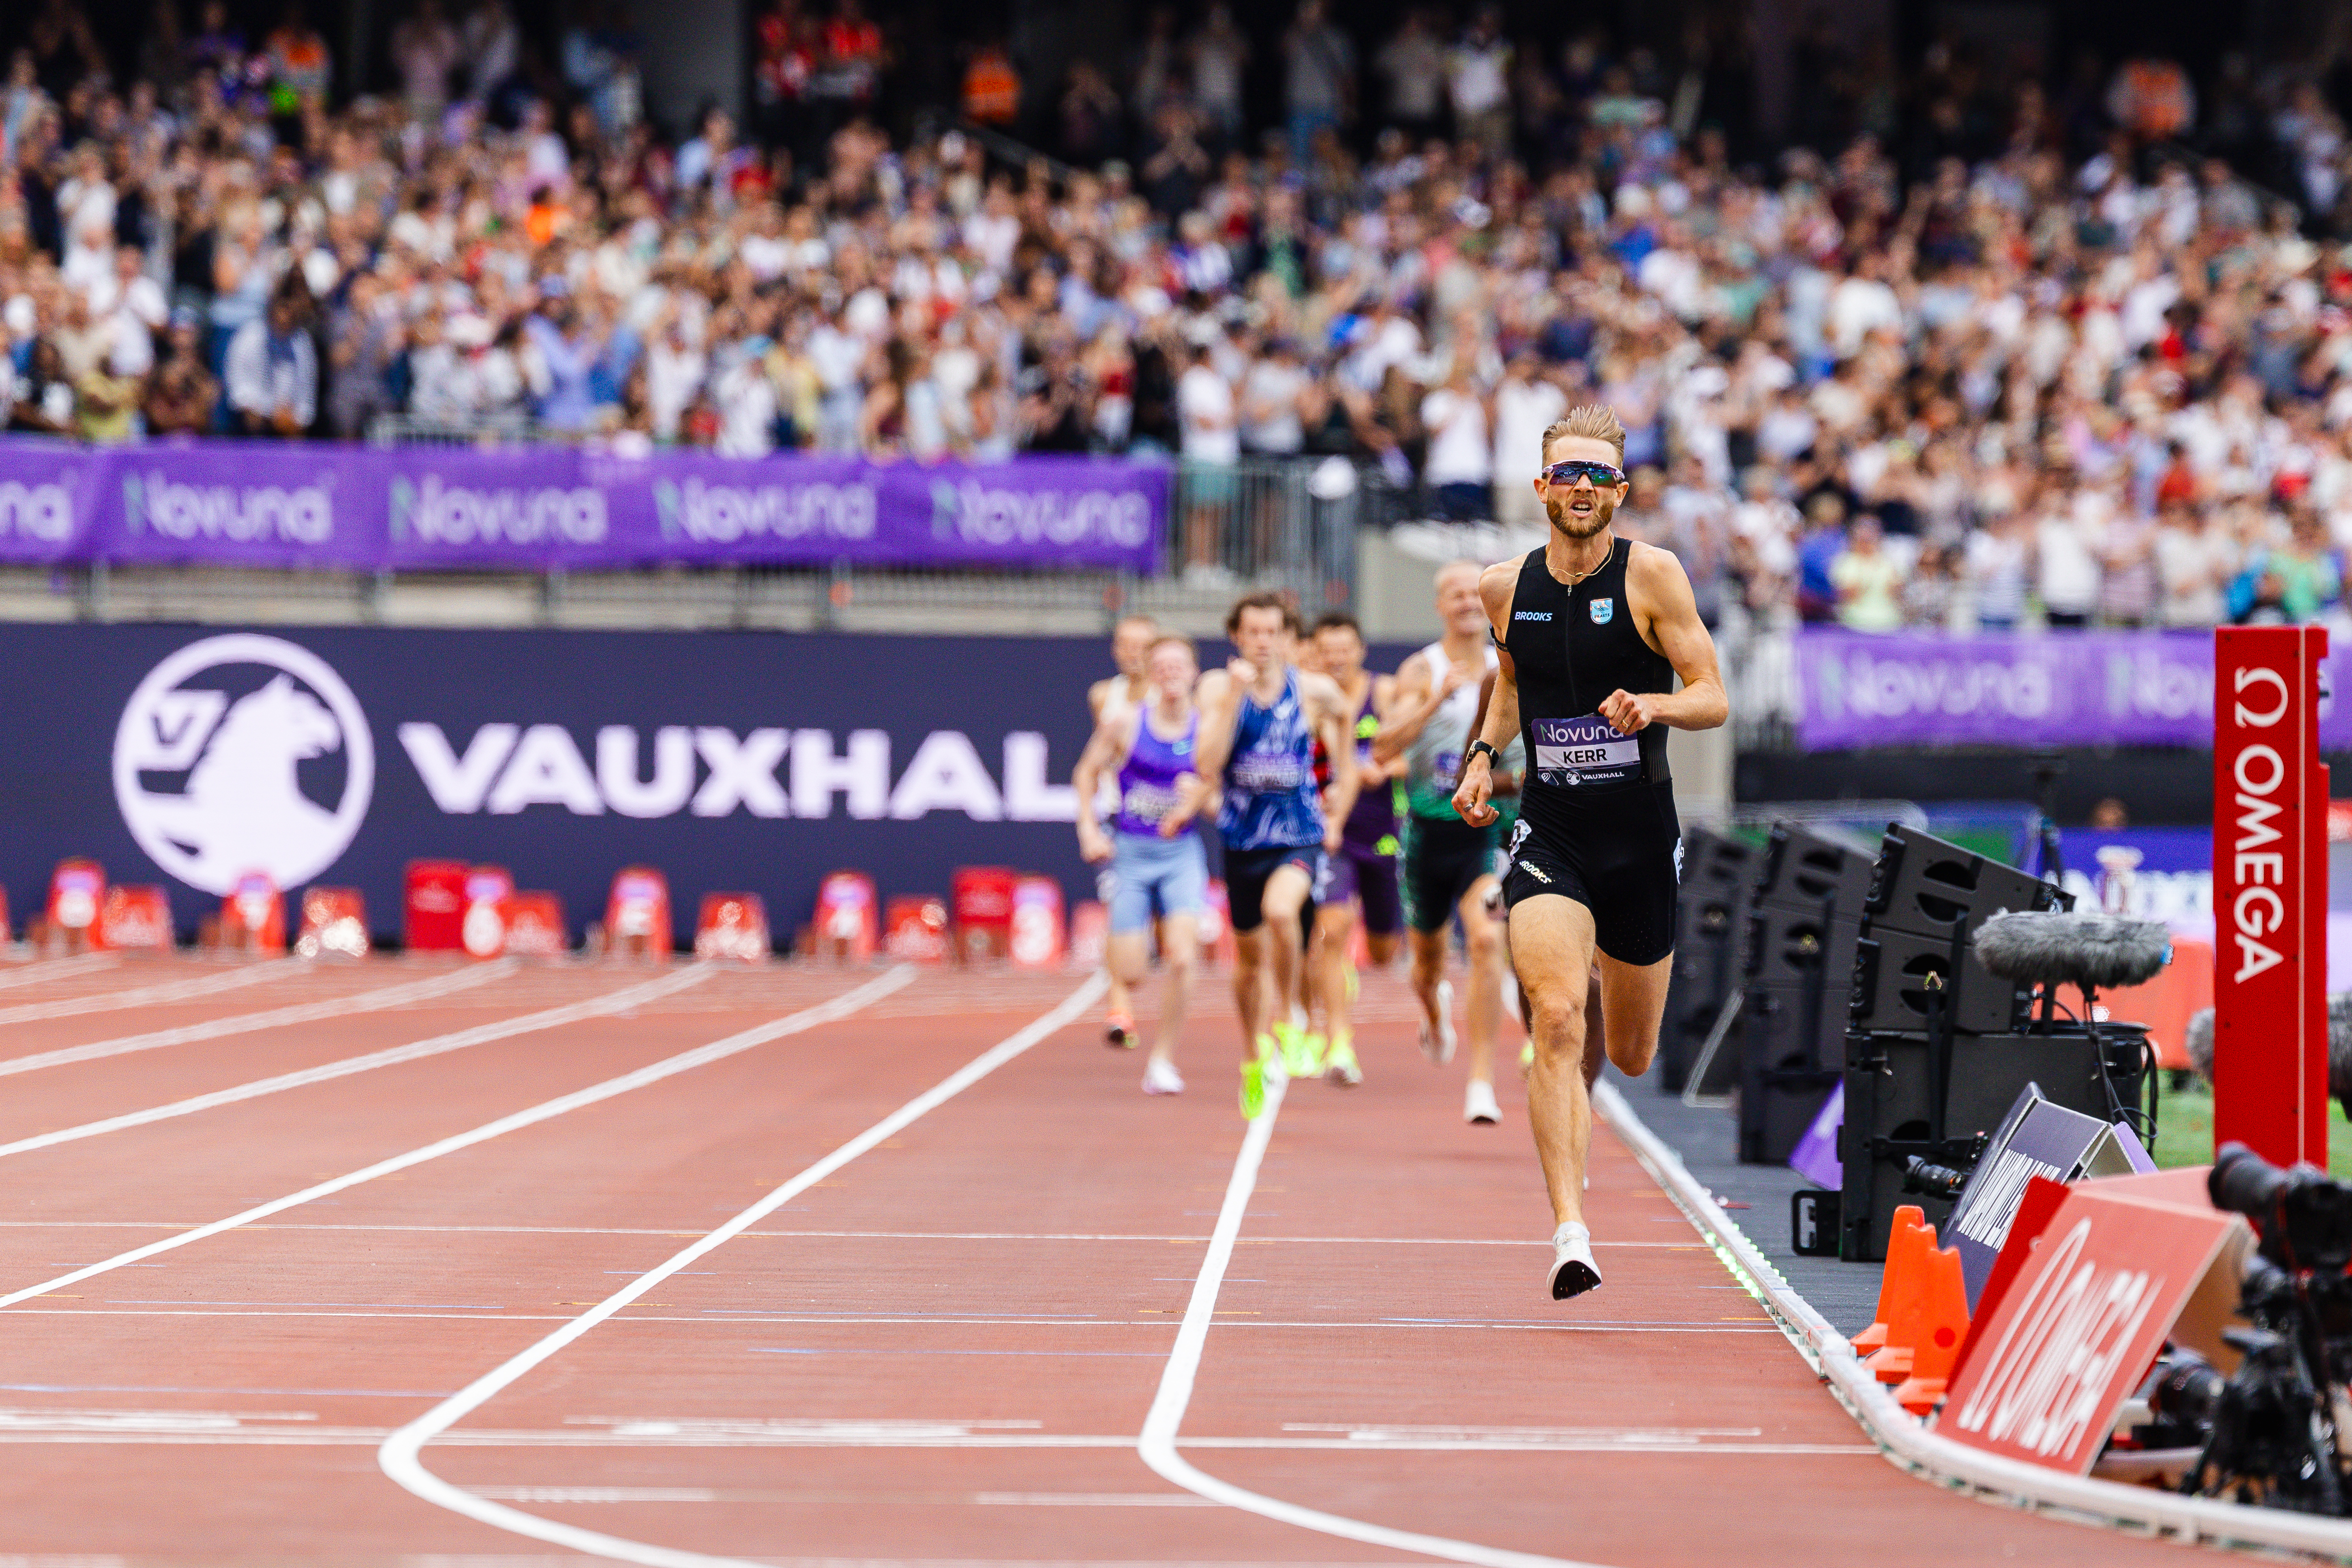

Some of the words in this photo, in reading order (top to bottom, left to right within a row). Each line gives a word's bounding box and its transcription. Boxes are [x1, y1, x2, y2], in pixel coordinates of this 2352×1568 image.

[1514, 612, 1553, 621] BROOKS
[396, 722, 1083, 823] VAUXHAL
[1563, 748, 1608, 764] KERR
[2234, 743, 2285, 984] OMEGA
